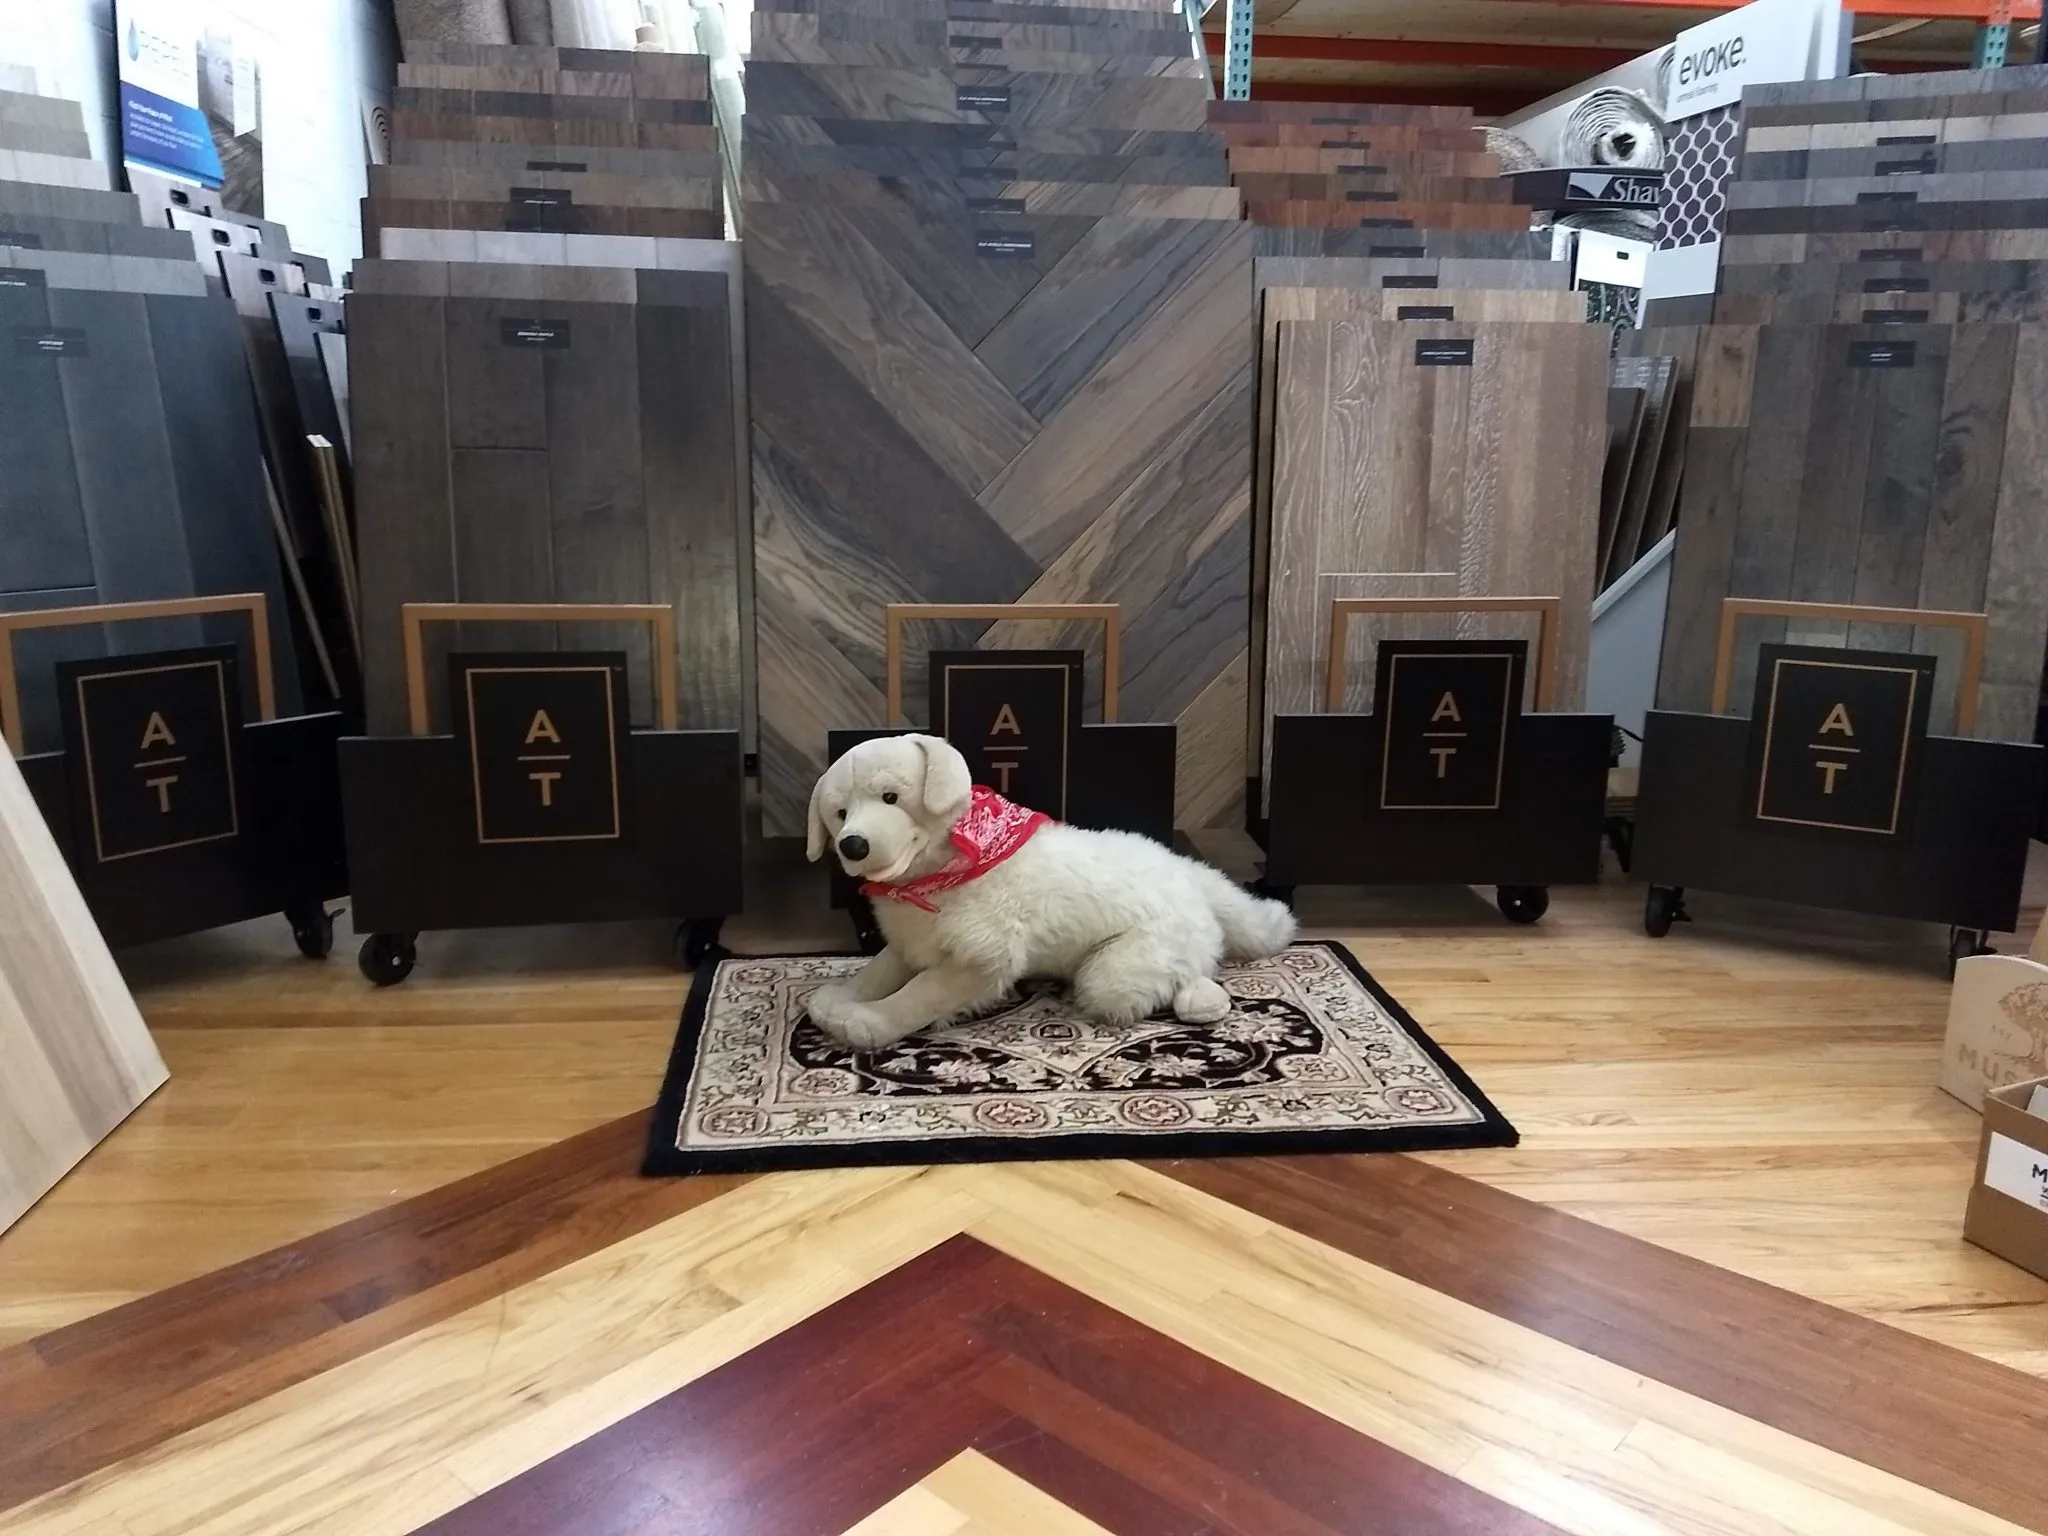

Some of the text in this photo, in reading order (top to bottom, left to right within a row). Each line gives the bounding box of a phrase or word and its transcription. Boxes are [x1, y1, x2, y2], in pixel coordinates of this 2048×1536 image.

[990, 703, 1021, 735] A
[1431, 691, 1461, 722] A
[1818, 702, 1854, 737] A
[140, 711, 176, 749] A
[525, 708, 561, 744] A
[991, 762, 1019, 793] T
[1429, 747, 1457, 778] T
[1815, 761, 1848, 794] T
[146, 775, 178, 813] T
[528, 772, 561, 806] T
